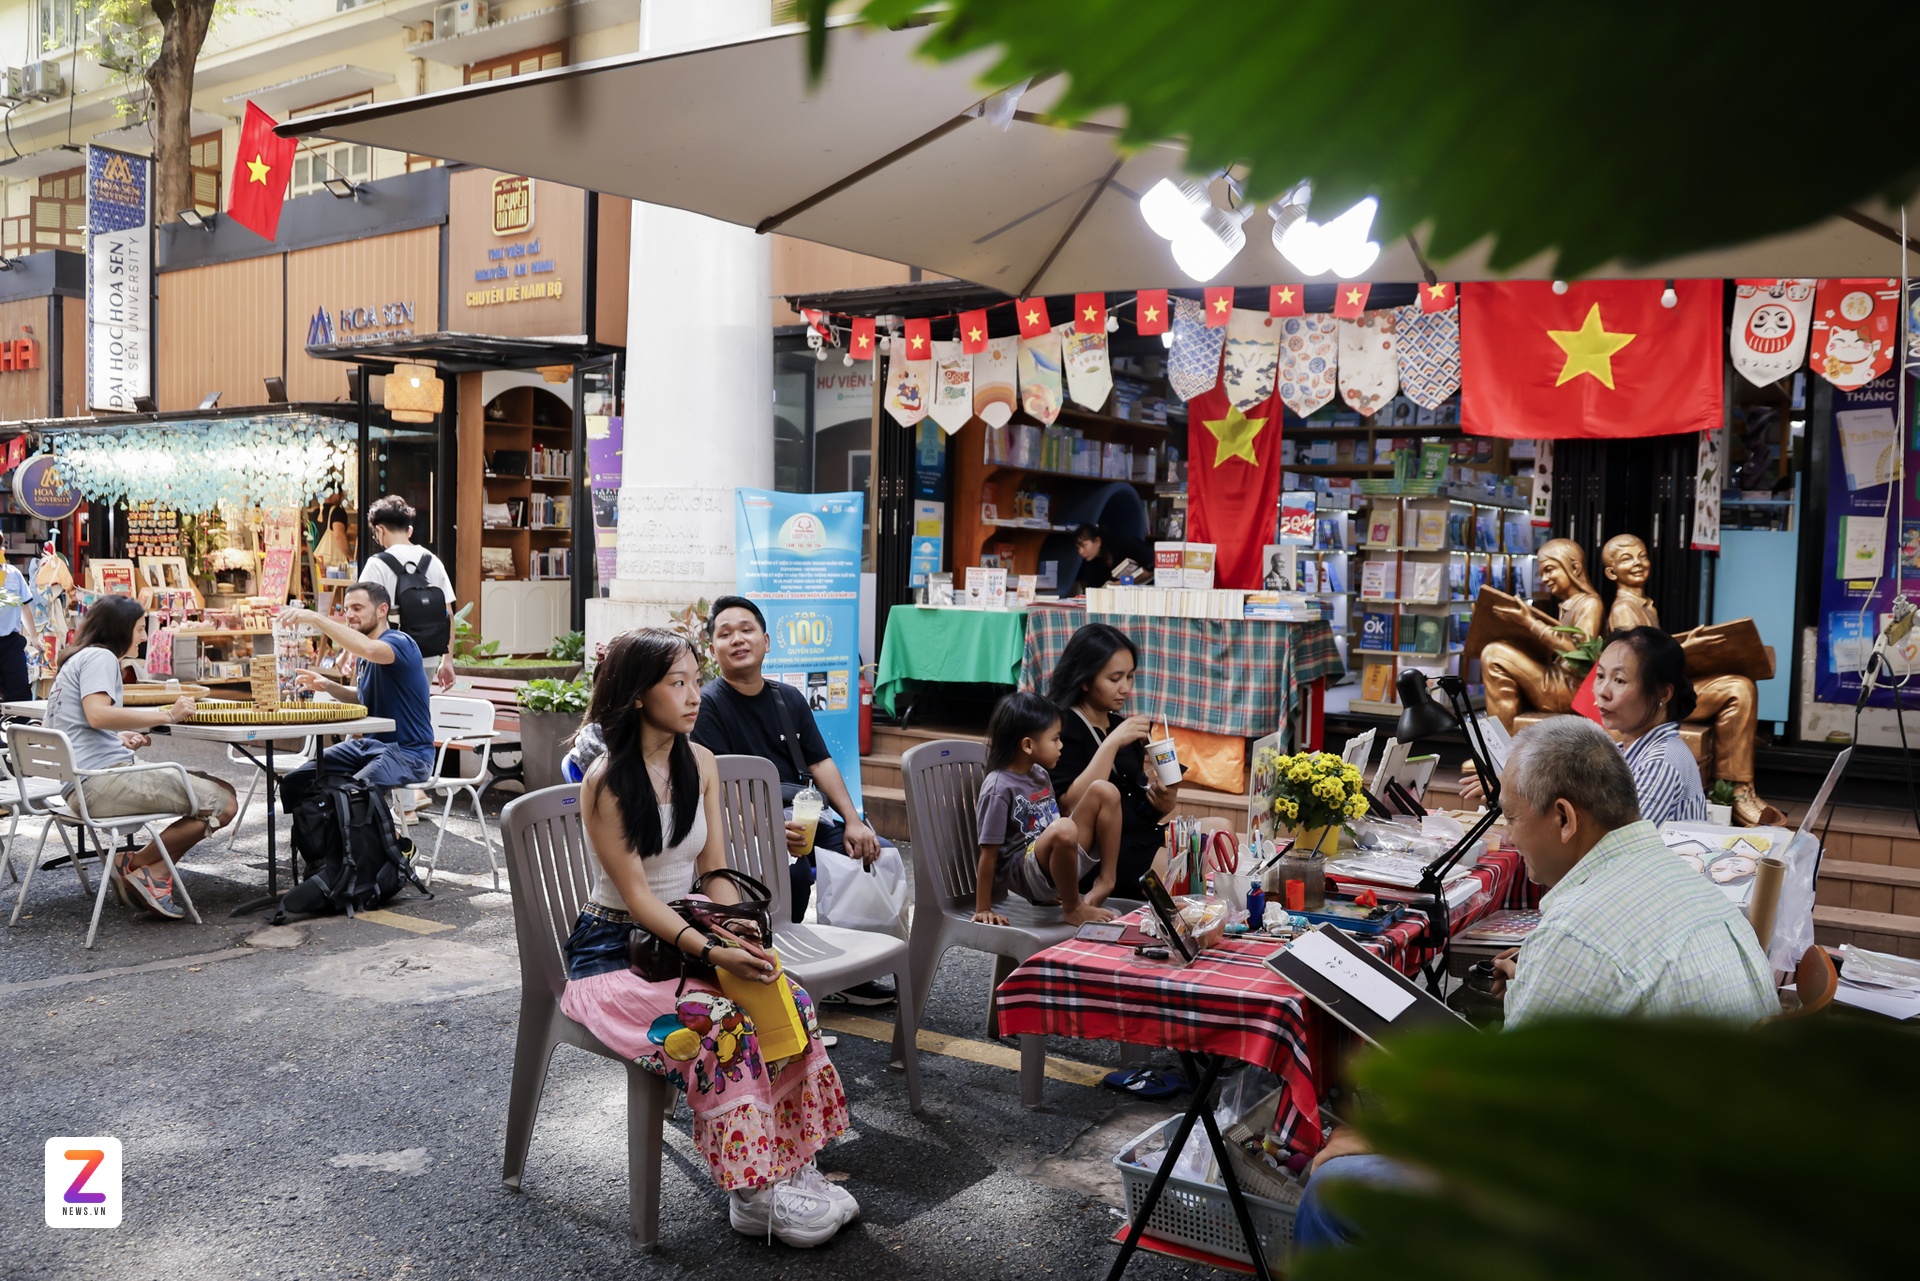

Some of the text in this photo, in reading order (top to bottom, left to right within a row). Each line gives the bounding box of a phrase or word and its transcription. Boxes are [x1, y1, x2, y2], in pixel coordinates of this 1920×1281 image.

[497, 206, 527, 229] AN NINH
[514, 263, 527, 276] AN
[128, 236, 139, 332] UNIVERSITY
[466, 286, 505, 306] CHUYÊN
[521, 283, 546, 300] NAM
[547, 278, 562, 299] BỘ
[340, 300, 415, 331] HOA SEN
[1846, 296, 1869, 316] 福
[109, 241, 128, 408] ĐẠI HỌC HOA SEN
[128, 341, 139, 371] SEN
[817, 374, 836, 389] HƯ
[838, 371, 866, 391] VIỆN
[1846, 389, 1895, 402] THÁNG
[34, 488, 53, 496] HOA
[795, 612, 816, 620] TOP
[1363, 619, 1386, 634] OK
[786, 619, 825, 646] 100
